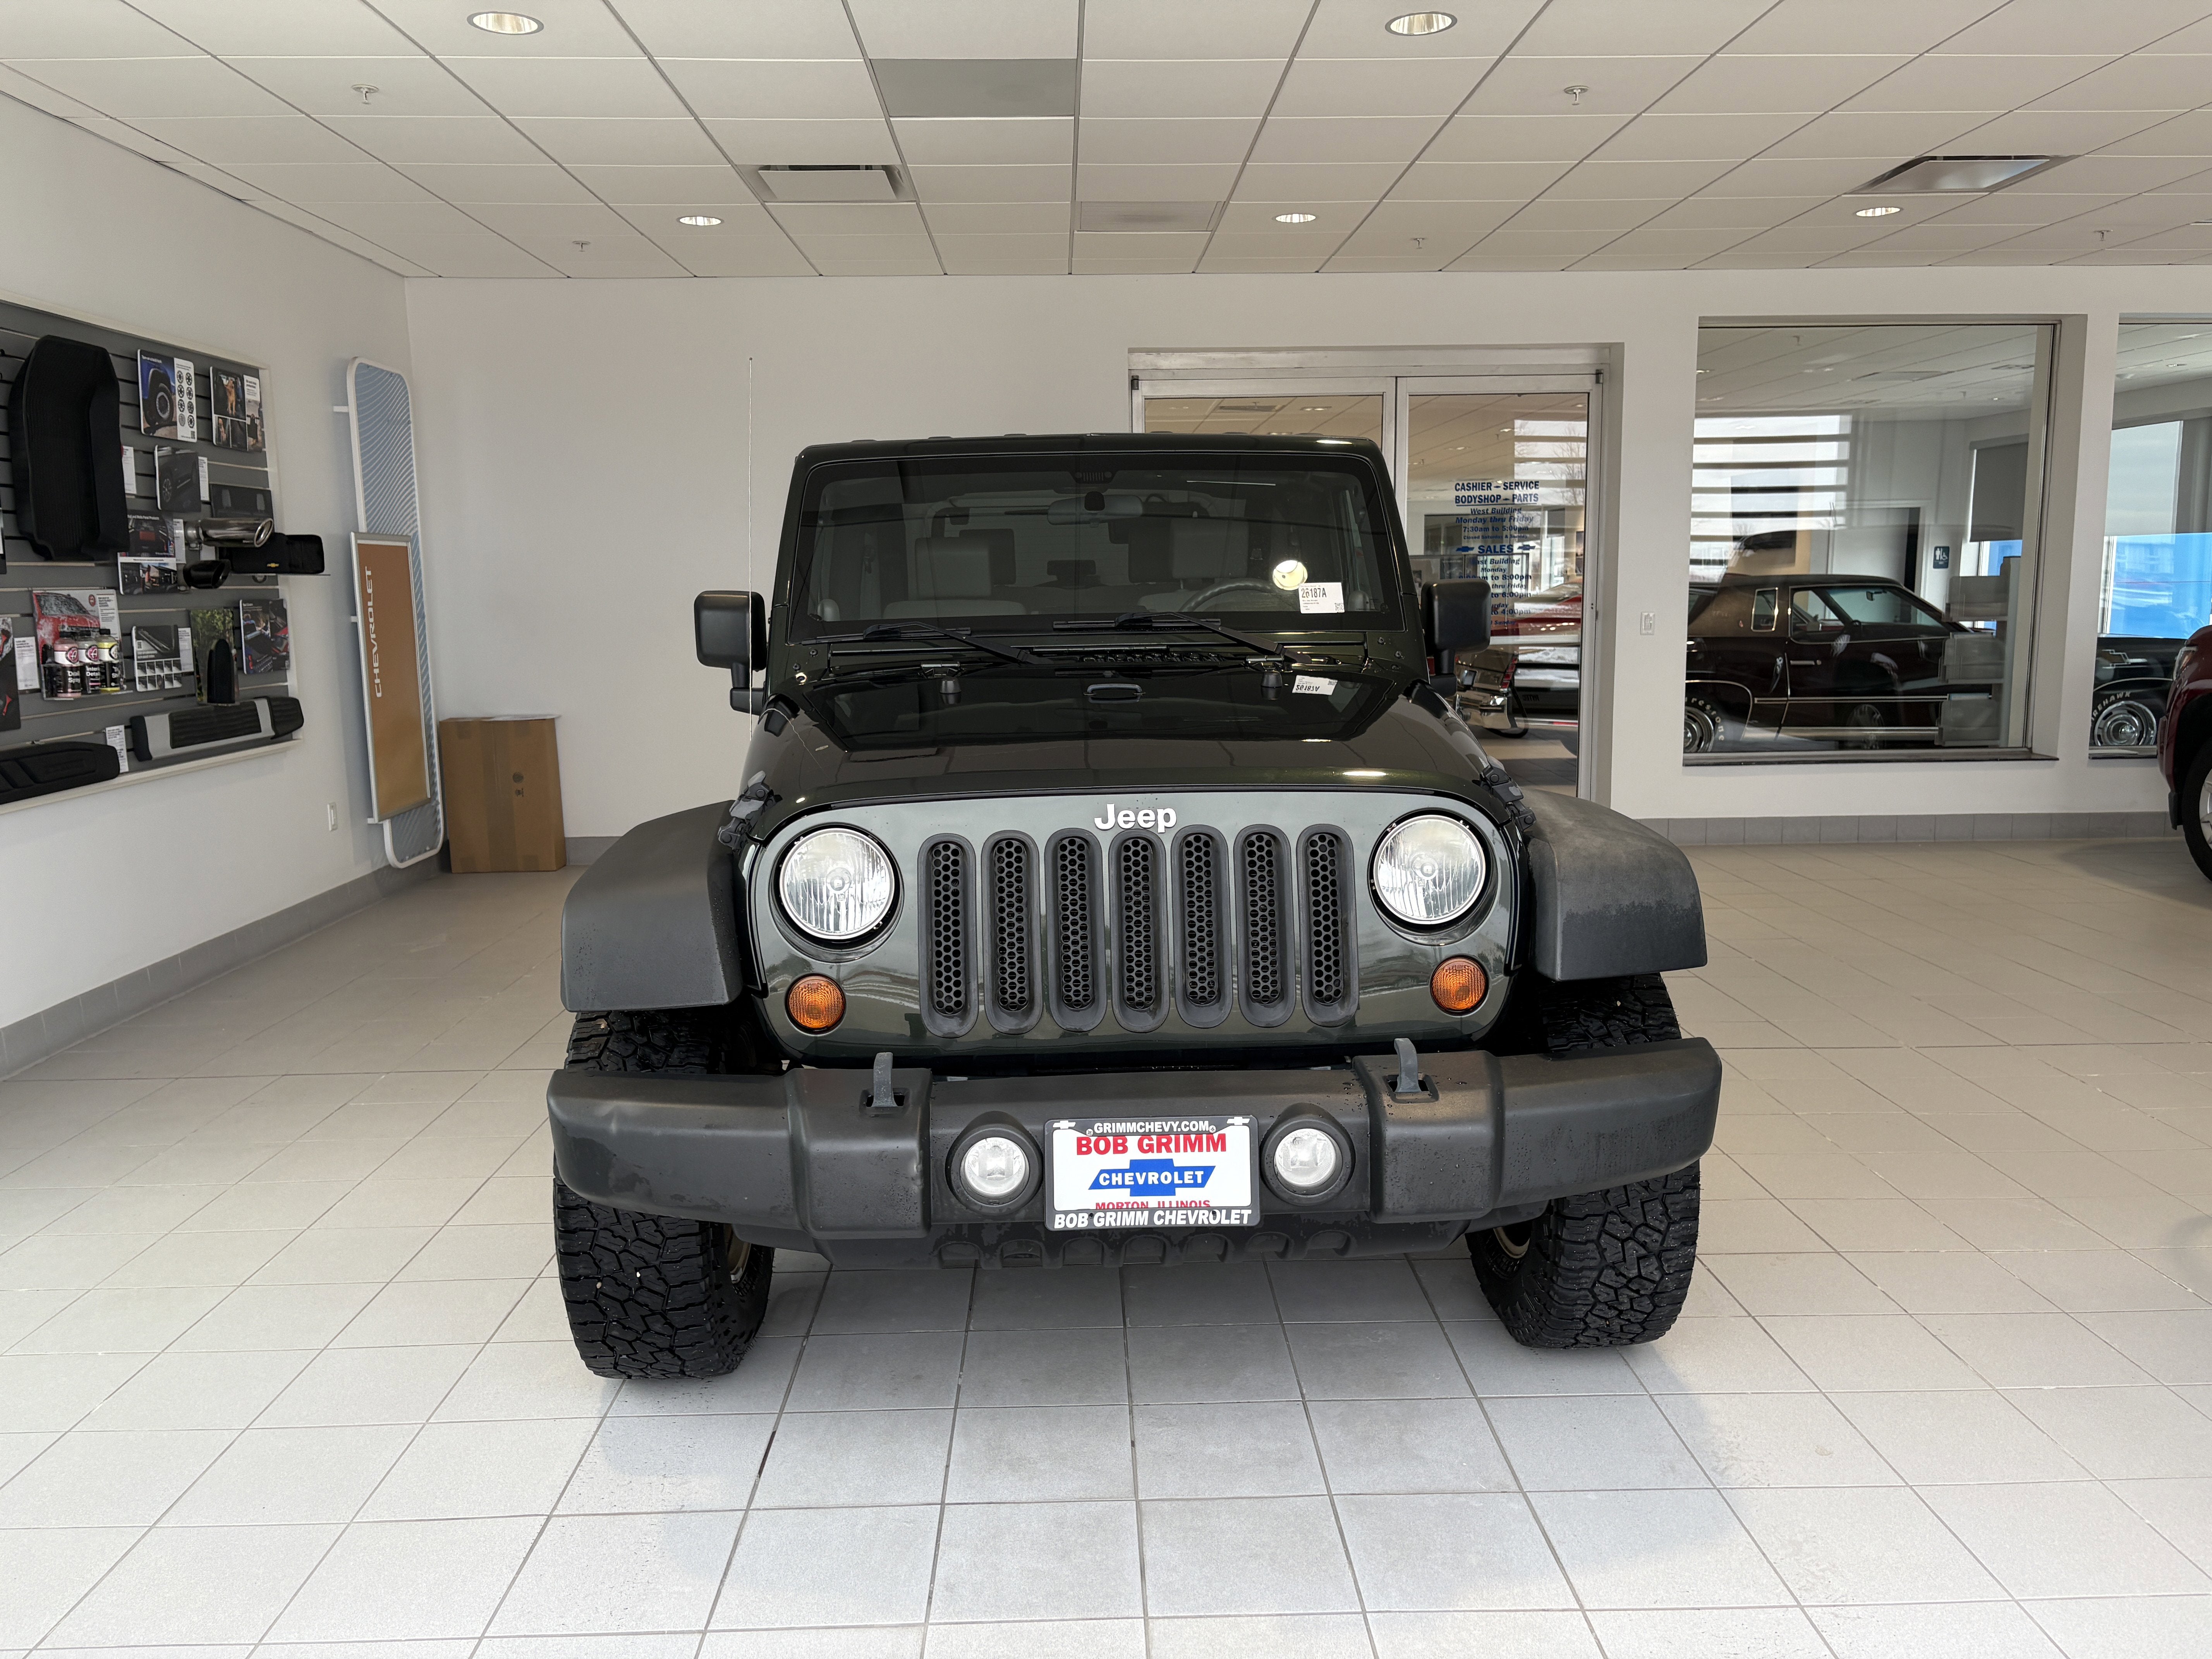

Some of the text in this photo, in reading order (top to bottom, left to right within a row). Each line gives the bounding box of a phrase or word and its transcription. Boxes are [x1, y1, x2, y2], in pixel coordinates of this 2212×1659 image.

[1455, 481, 1539, 491] CASHIER SERVICE
[1455, 493, 1539, 504] BODYSHOP PARTS
[1478, 544, 1514, 554] SALES
[1301, 588, 1326, 598] 26187A
[366, 566, 382, 697] CHEVROLET
[2092, 691, 2131, 721] IREHAWK
[1685, 697, 1724, 741] irestone
[1094, 803, 1177, 833] Jeep
[1094, 1121, 1209, 1133] GRIMMCHEVY.COM
[1077, 1133, 1226, 1155] BOB GRIMM
[1099, 1171, 1204, 1186] CHEVROLET
[1054, 1209, 1252, 1229] BOB GRIMM CHEVROLET
